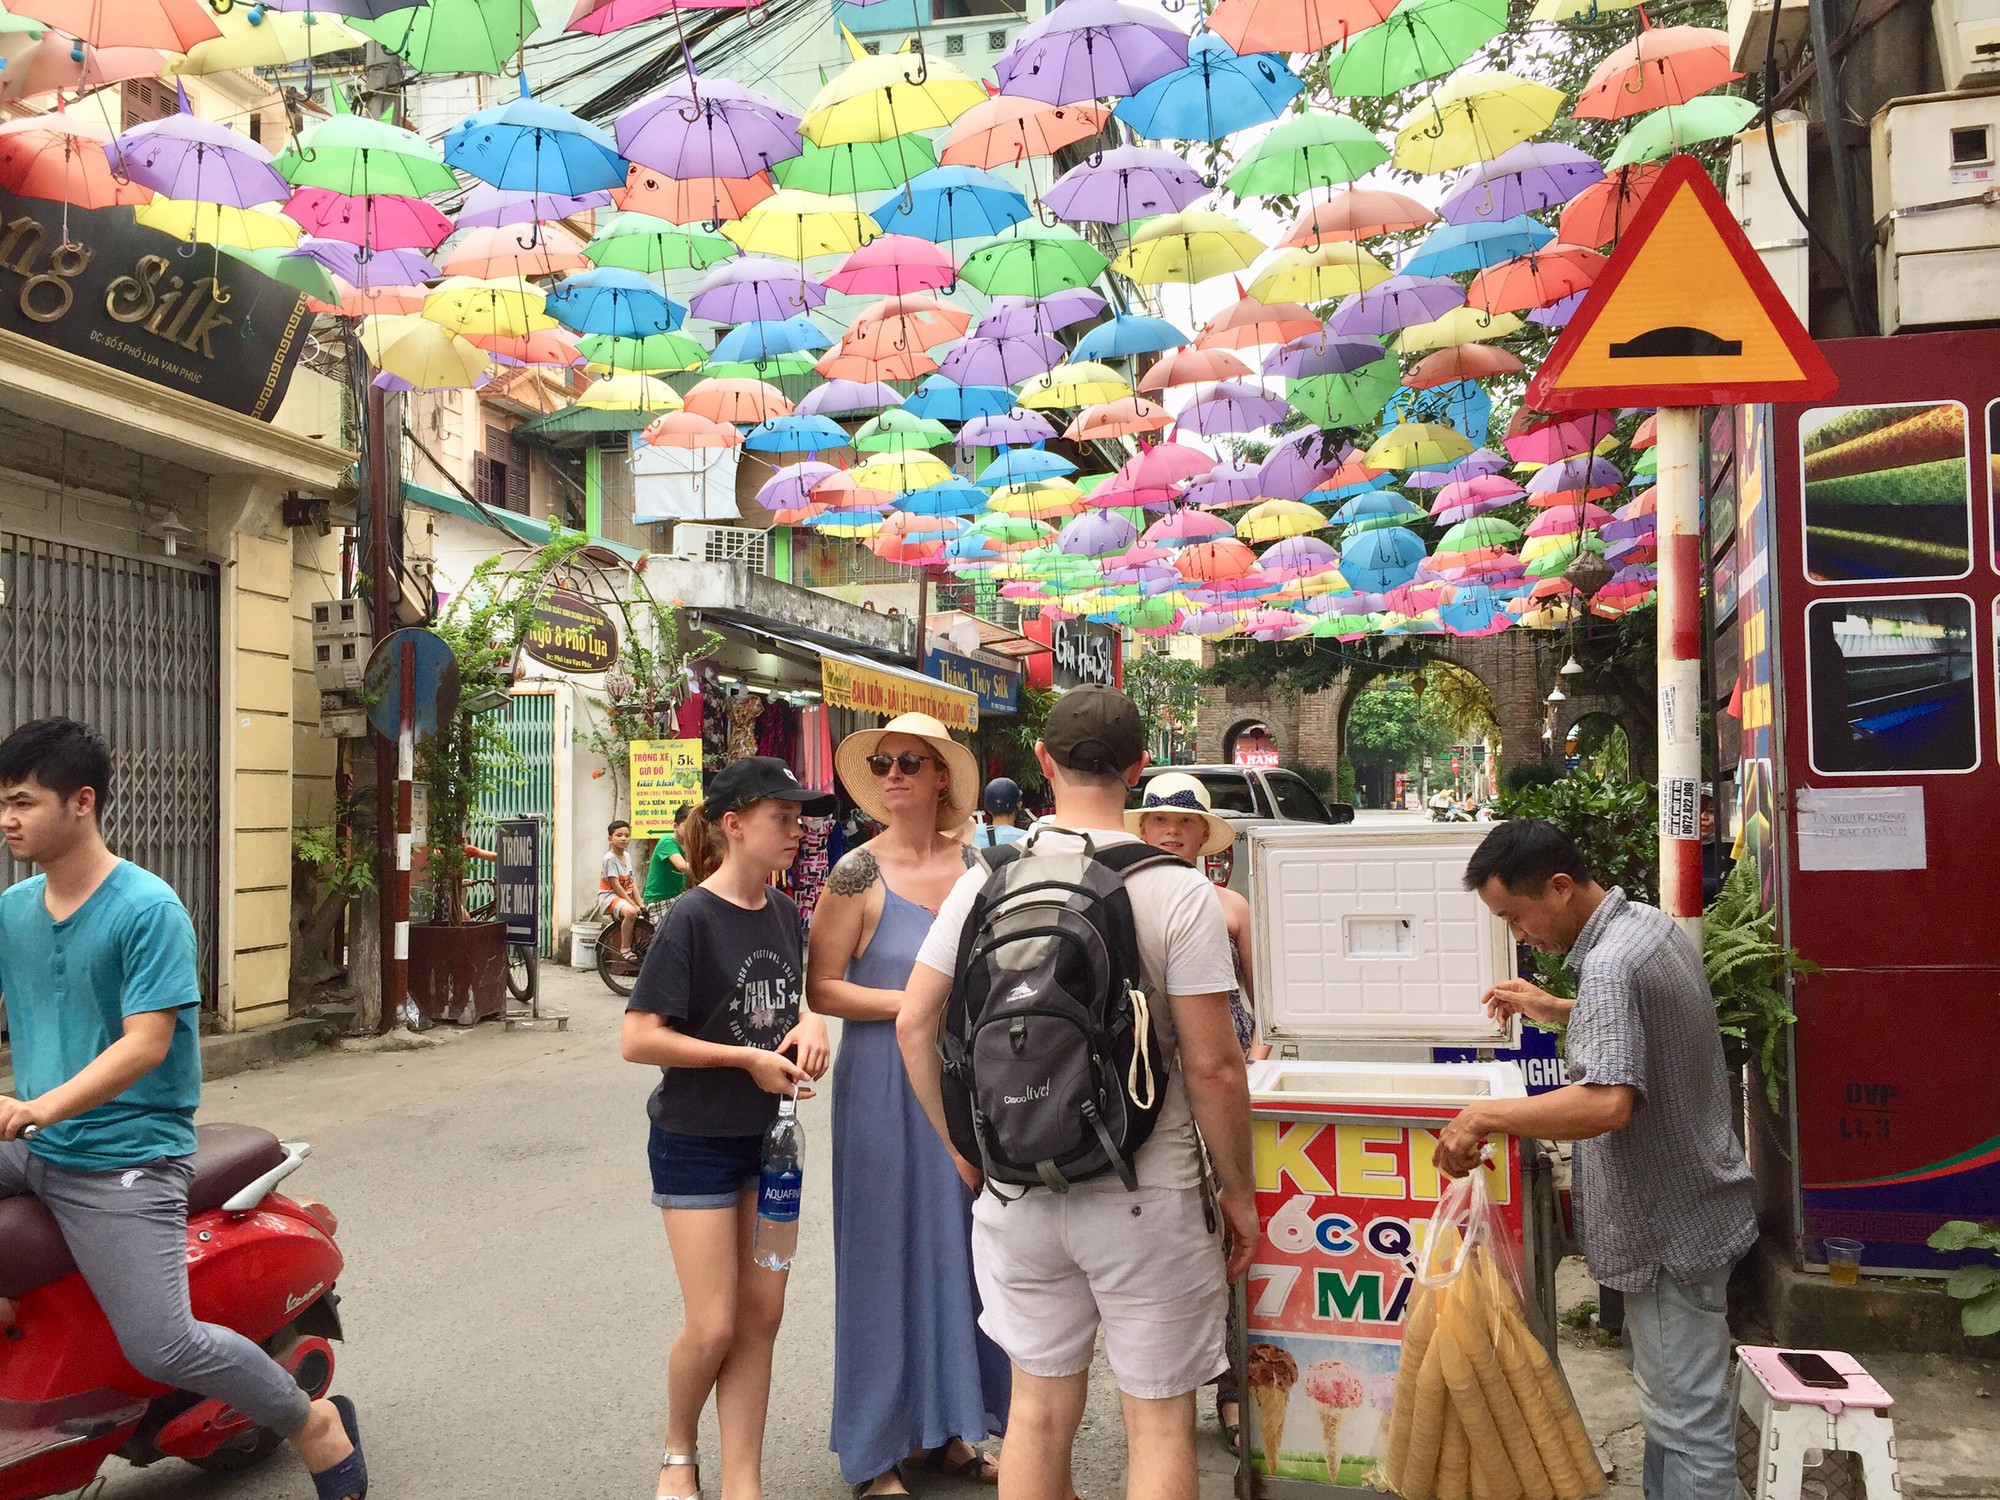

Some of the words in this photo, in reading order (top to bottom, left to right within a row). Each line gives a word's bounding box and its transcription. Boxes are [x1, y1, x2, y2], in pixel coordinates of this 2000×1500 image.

[105, 254, 233, 361] Silk
[123, 344, 142, 359] PHỐ
[141, 352, 159, 367] LỤA
[555, 626, 562, 646] 8
[589, 634, 608, 661] Lụa
[660, 753, 669, 761] XE
[677, 754, 694, 765] 5k
[1682, 782, 1694, 834] 0972.822.098
[503, 829, 532, 866] TRÔNG
[500, 884, 511, 914] XE
[514, 878, 534, 914] MÁY
[765, 1187, 801, 1201] AQUAFIN
[284, 1281, 324, 1315] Vespa
[1248, 1263, 1302, 1317] 7
